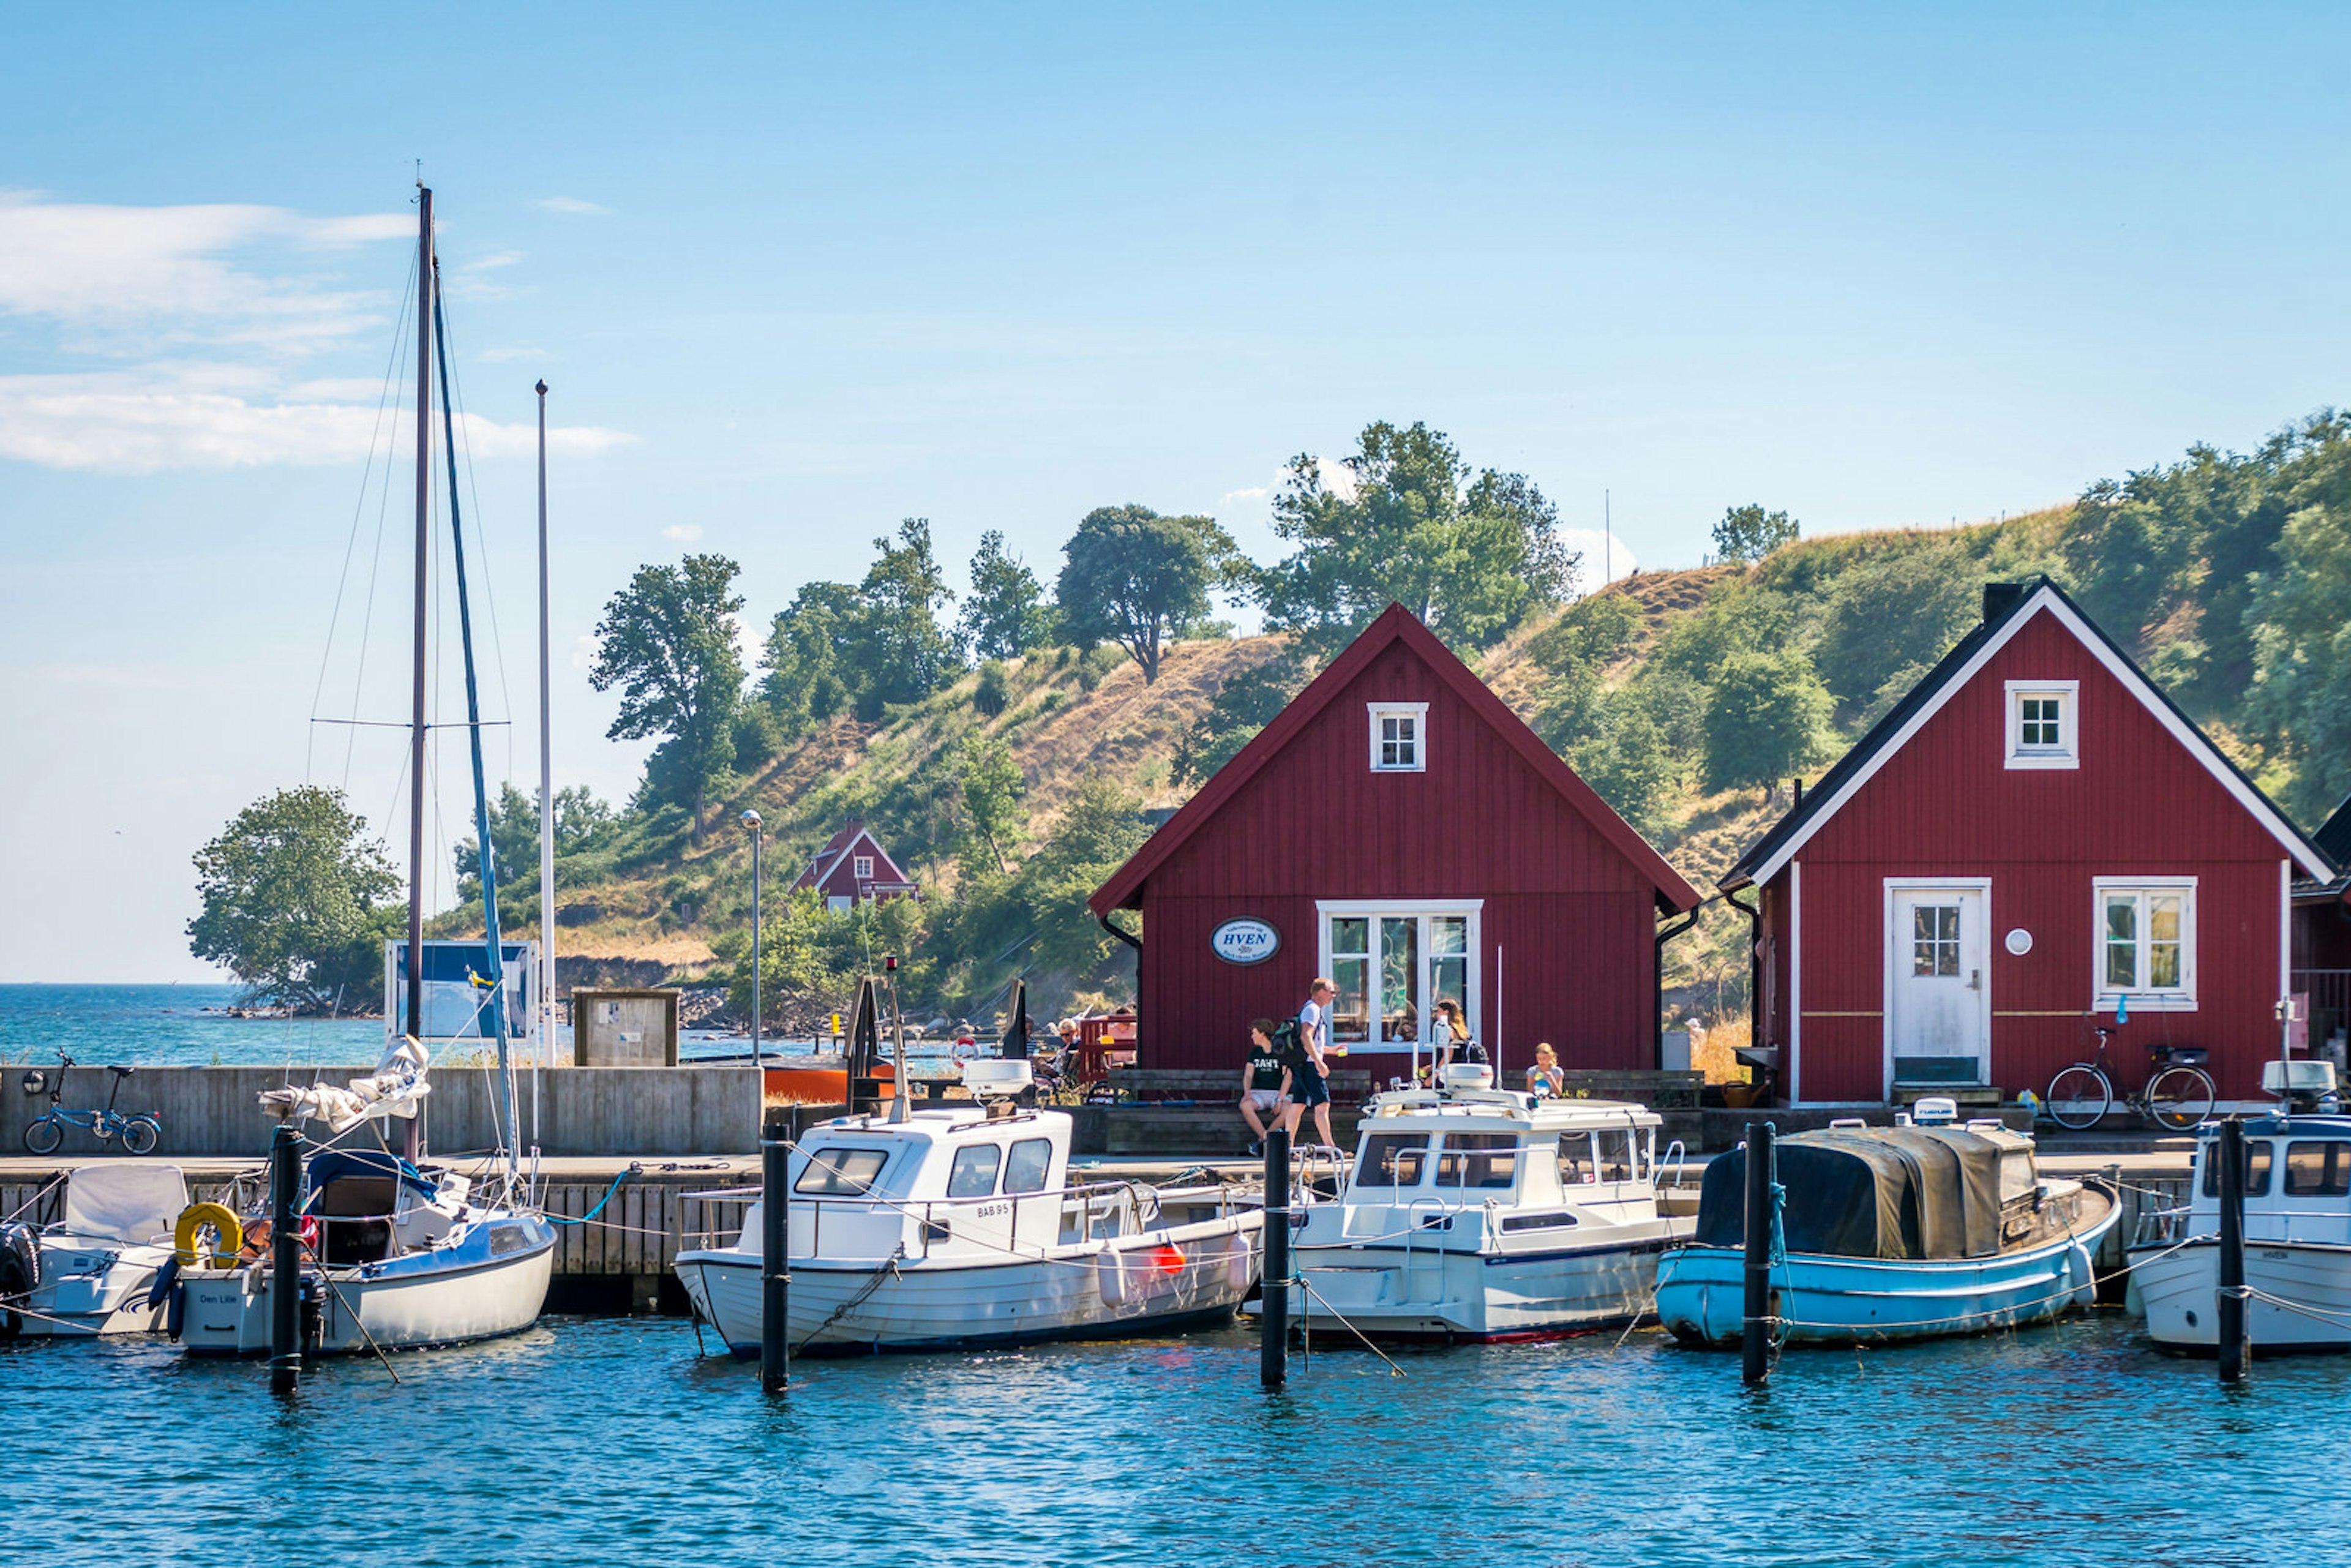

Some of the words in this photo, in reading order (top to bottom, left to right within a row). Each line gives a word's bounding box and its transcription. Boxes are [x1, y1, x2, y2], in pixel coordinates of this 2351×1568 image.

[1224, 933, 1267, 944] HVEN
[977, 1206, 995, 1217] BAB
[996, 1203, 1008, 1214] 95
[200, 1294, 217, 1303] Den
